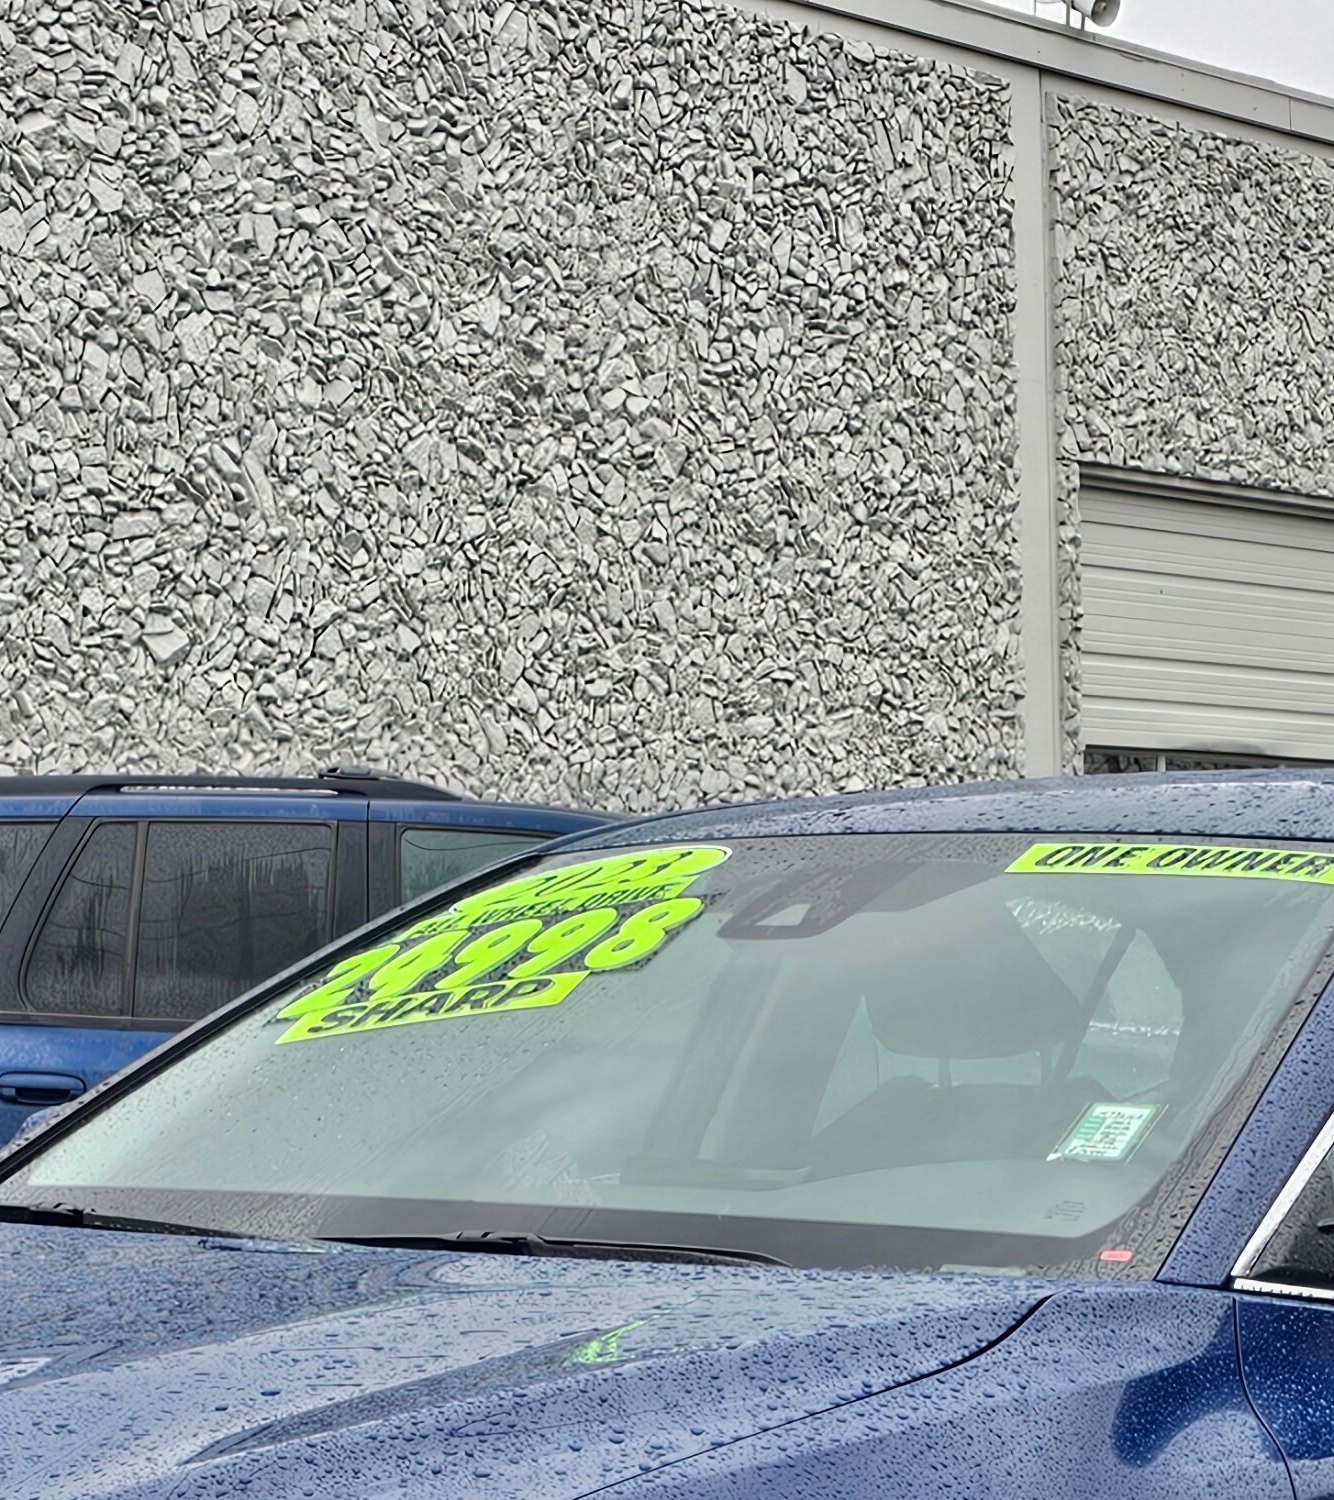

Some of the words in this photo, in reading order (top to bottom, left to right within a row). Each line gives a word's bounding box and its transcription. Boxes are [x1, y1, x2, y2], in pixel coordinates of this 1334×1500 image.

[1035, 846, 1149, 870] ONE
[276, 897, 701, 1020] 24998
[307, 978, 557, 1034] SHARP
